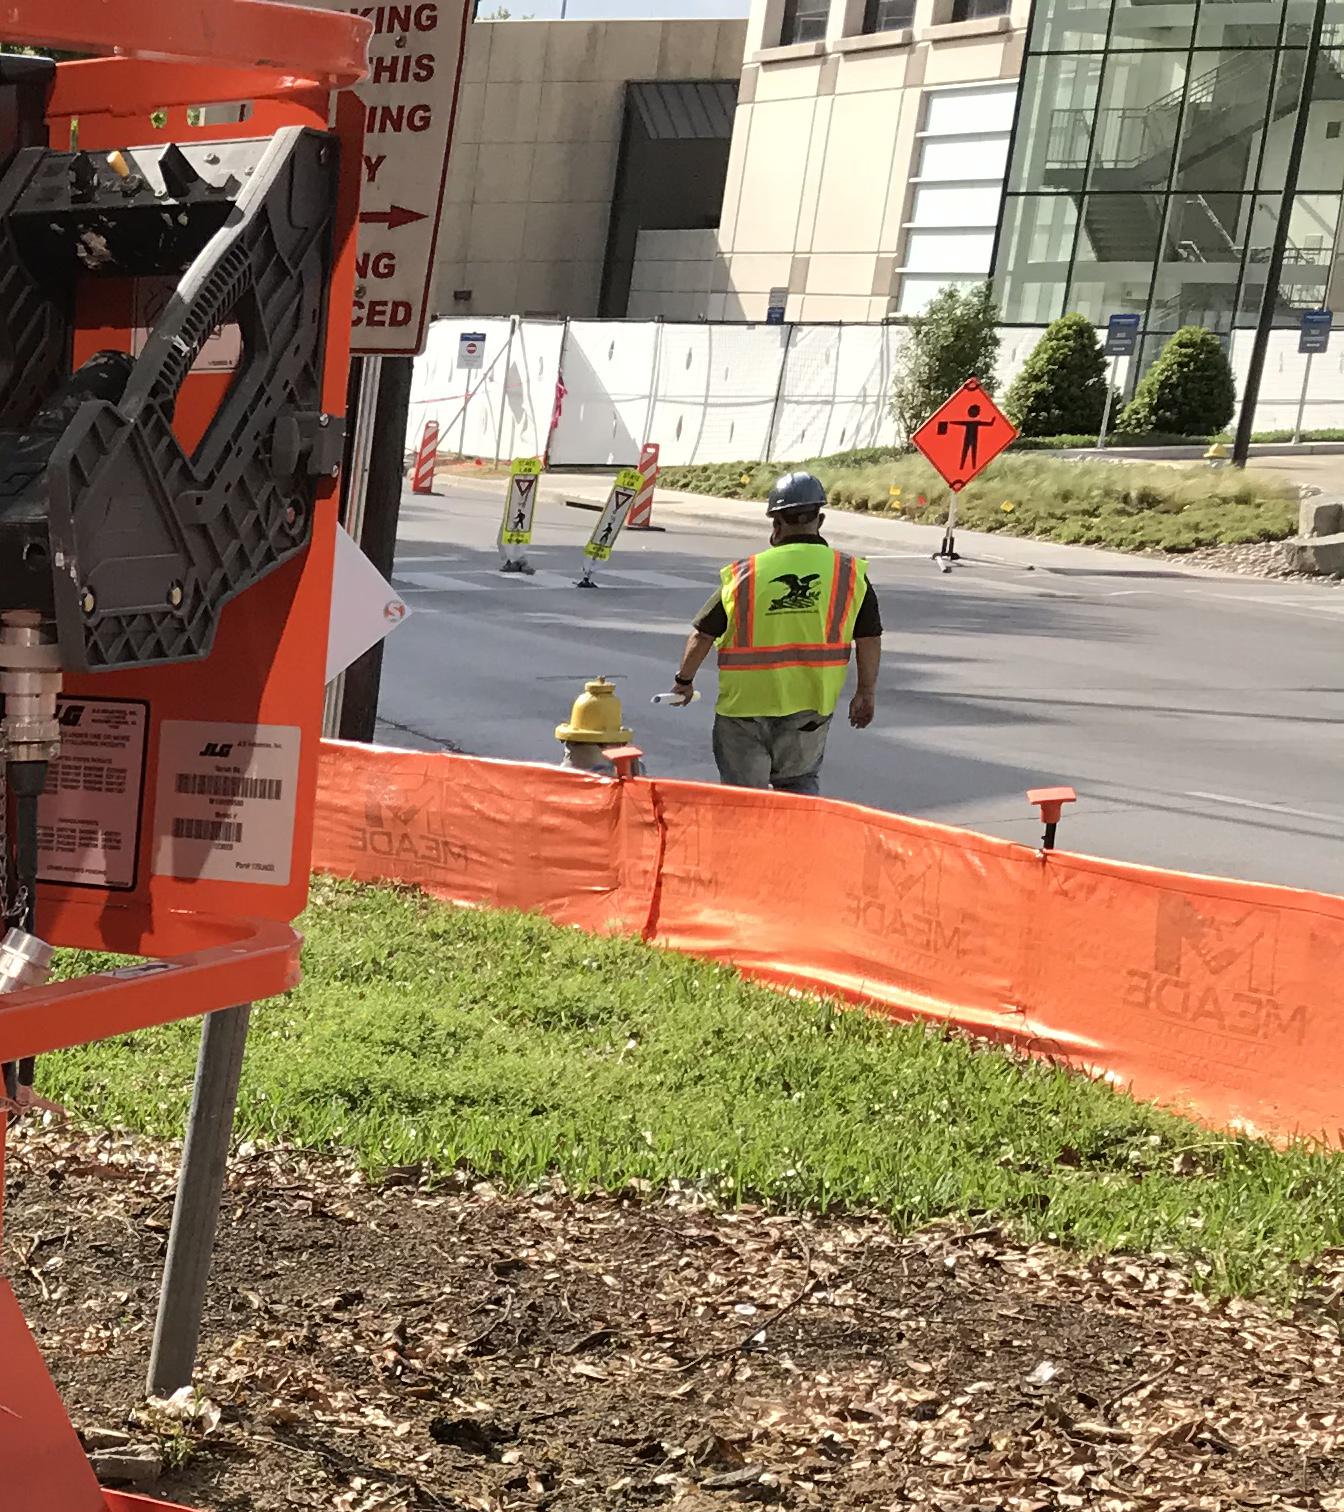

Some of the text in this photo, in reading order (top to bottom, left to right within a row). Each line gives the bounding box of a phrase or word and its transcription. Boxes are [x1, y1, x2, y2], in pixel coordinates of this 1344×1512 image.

[336, 2, 439, 34] ING
[369, 54, 435, 84] HIS
[365, 103, 432, 134] ING
[354, 251, 396, 279] NG
[351, 300, 412, 328] CED
[200, 742, 233, 758] JLG
